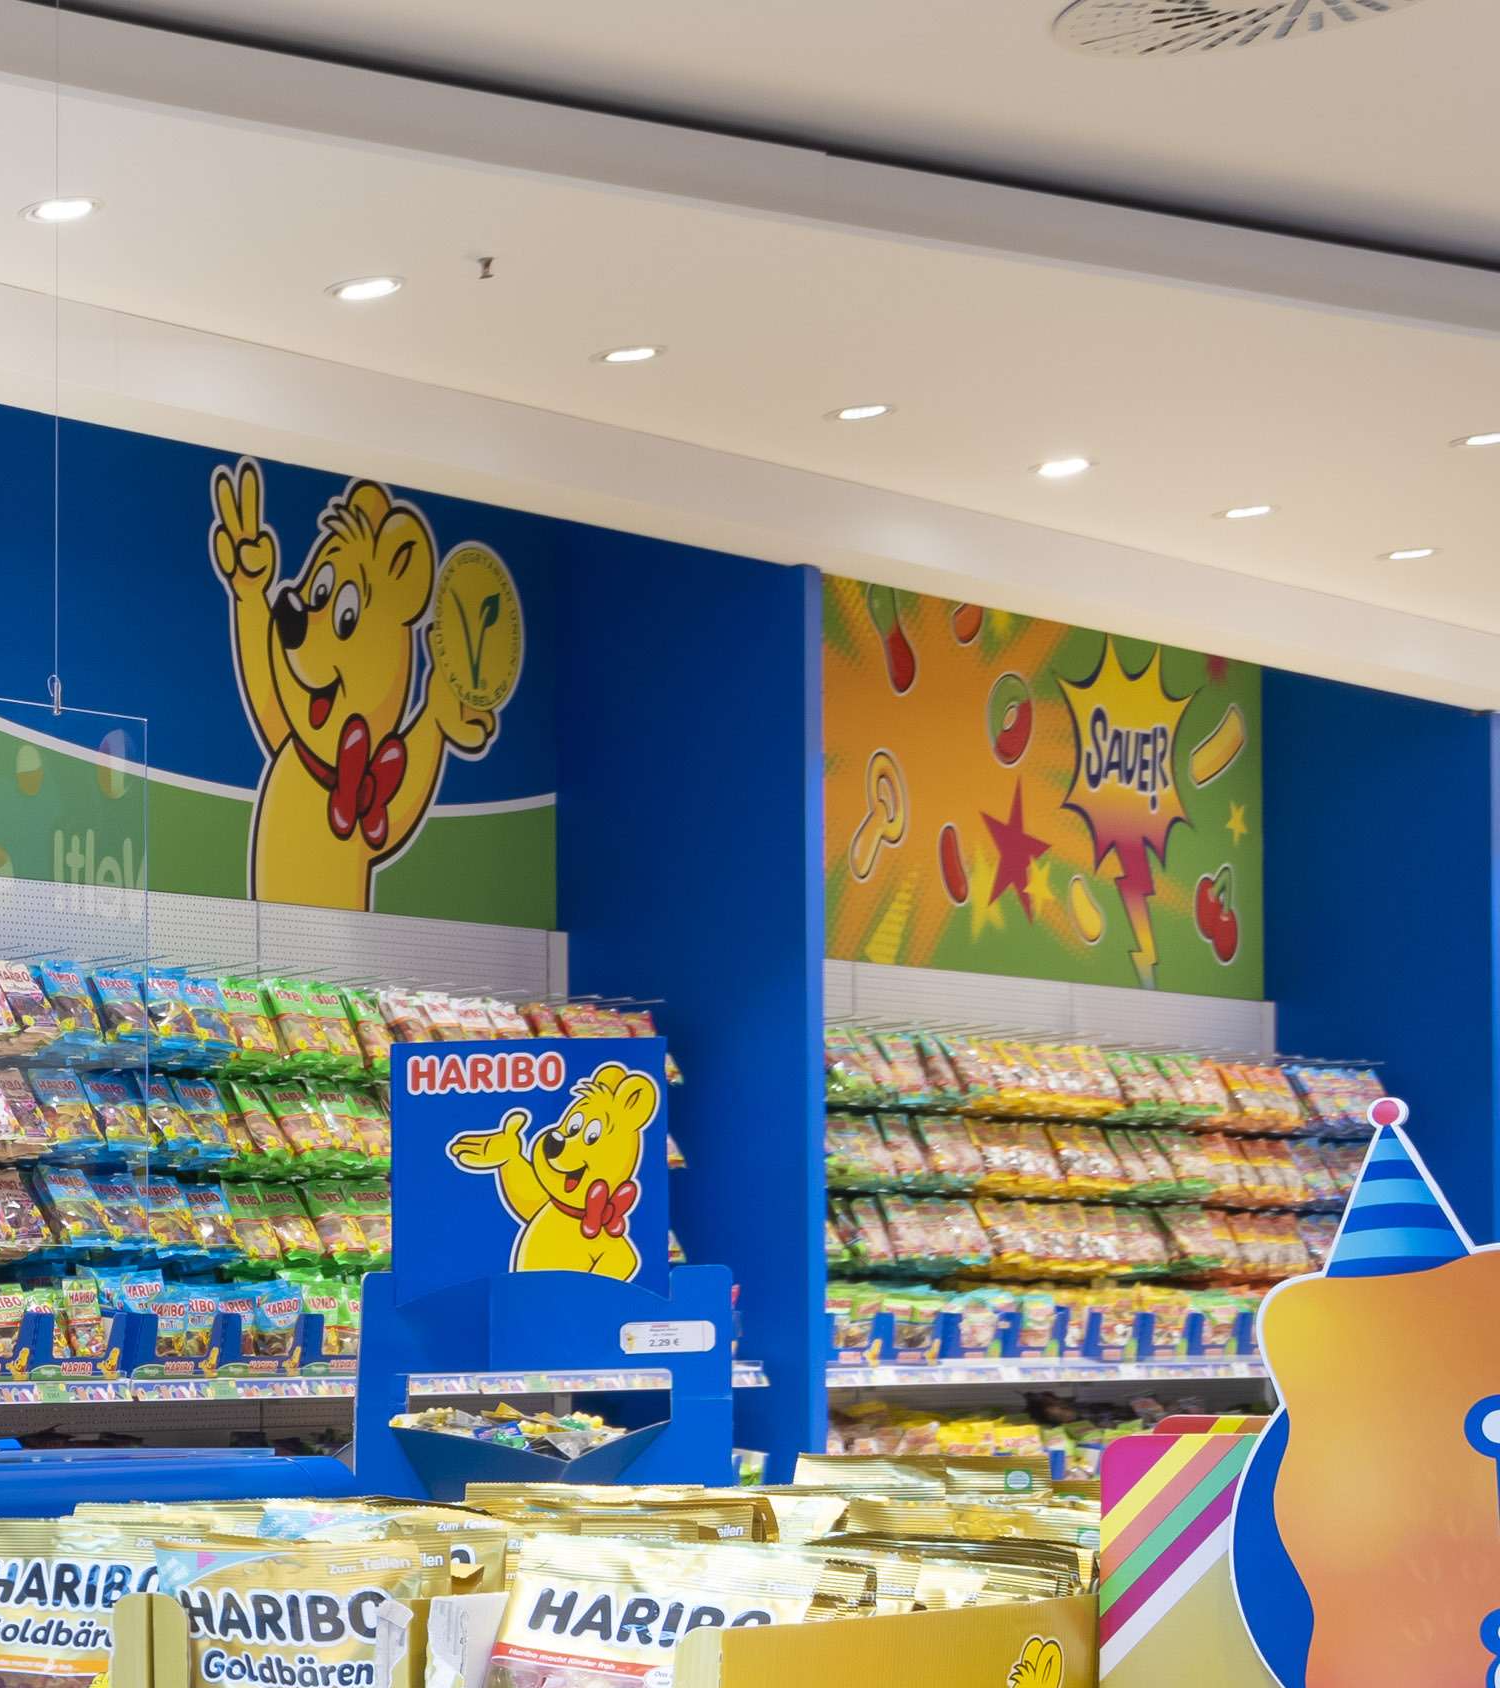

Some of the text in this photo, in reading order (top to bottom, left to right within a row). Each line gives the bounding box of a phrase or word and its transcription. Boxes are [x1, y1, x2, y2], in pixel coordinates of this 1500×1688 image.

[407, 1054, 563, 1095] HARIBO
[363, 1558, 412, 1572] Teilen
[179, 1590, 387, 1642] HARIBO
[204, 1650, 374, 1688] Goldbären
[508, 1647, 538, 1660] Haribo
[539, 1653, 566, 1665] macht
[567, 1657, 596, 1668] Kinder
